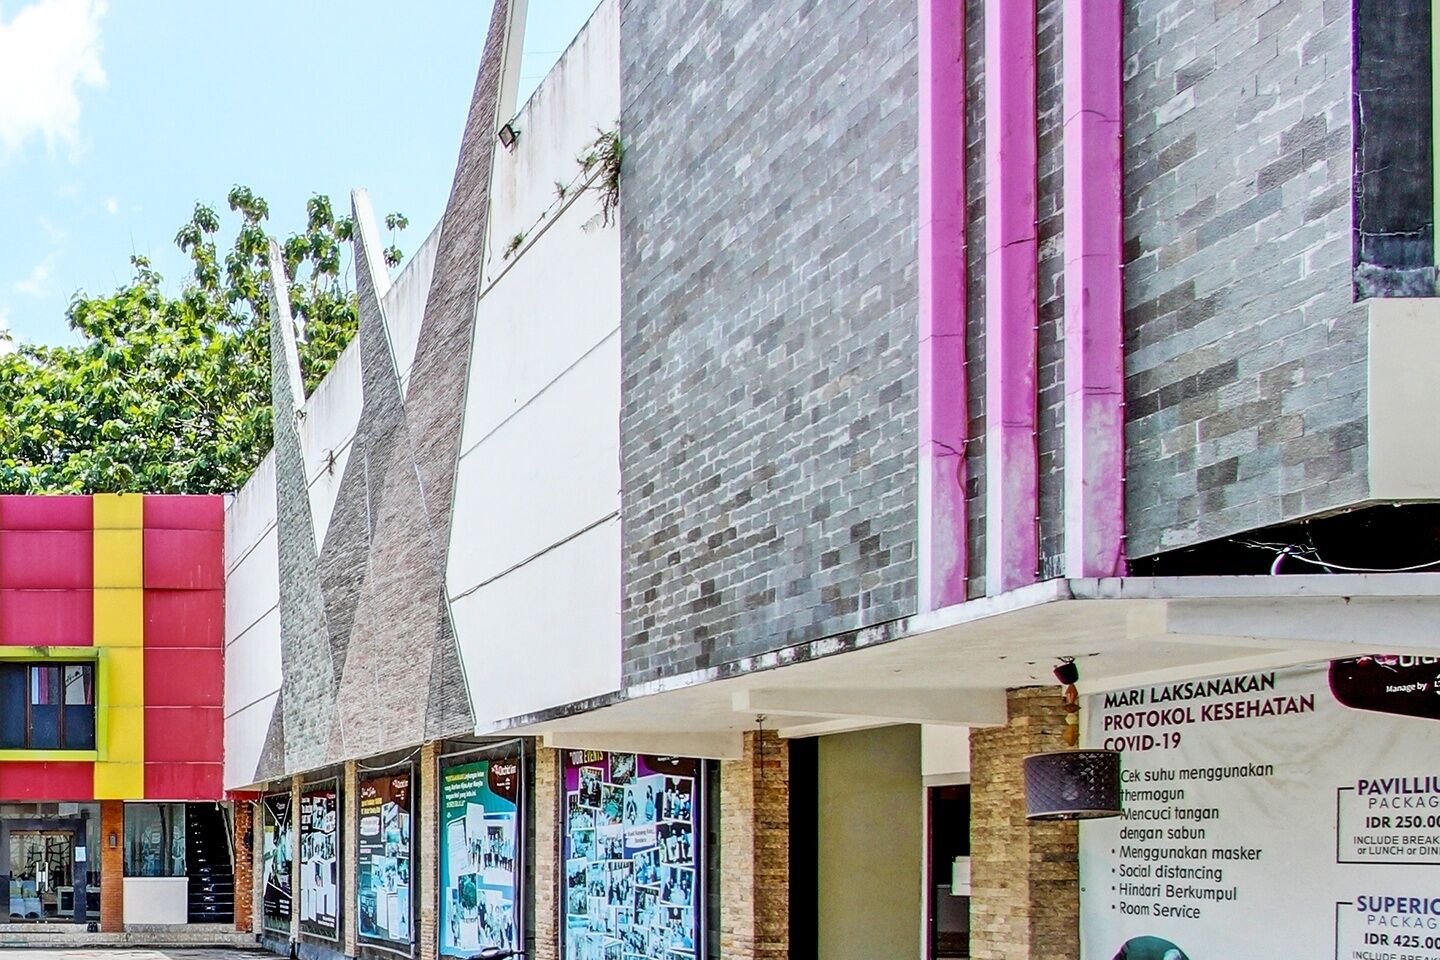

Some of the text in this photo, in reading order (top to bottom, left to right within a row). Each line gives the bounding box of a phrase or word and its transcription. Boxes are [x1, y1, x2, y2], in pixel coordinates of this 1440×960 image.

[1103, 672, 1276, 709] MARI LAKSANAKAN
[1385, 683, 1417, 694] Manage
[1417, 681, 1428, 692] by
[1103, 693, 1316, 732] PROTOKOL KESEHATAN
[1103, 731, 1182, 752] COVID-19
[1120, 763, 1274, 783] Cek suhu menggunakan
[1119, 788, 1185, 803] thermogun
[1368, 796, 1439, 809] PACKAG
[1120, 806, 1220, 822] Mencuci tangan
[1365, 816, 1391, 828] IDR
[1119, 826, 1206, 842] dengan sabun
[1353, 835, 1400, 845] INCLUDE
[1119, 845, 1263, 862] Menggunakan masker
[1357, 847, 1367, 855] or
[1368, 846, 1404, 855] LUNCH
[1406, 847, 1417, 855] or
[1119, 864, 1223, 882] Social distancing
[1119, 882, 1237, 902] Hindari Berkumpul
[1119, 901, 1201, 919] Room Service
[1367, 914, 1437, 930] PACKAG
[1364, 933, 1389, 946] IDR
